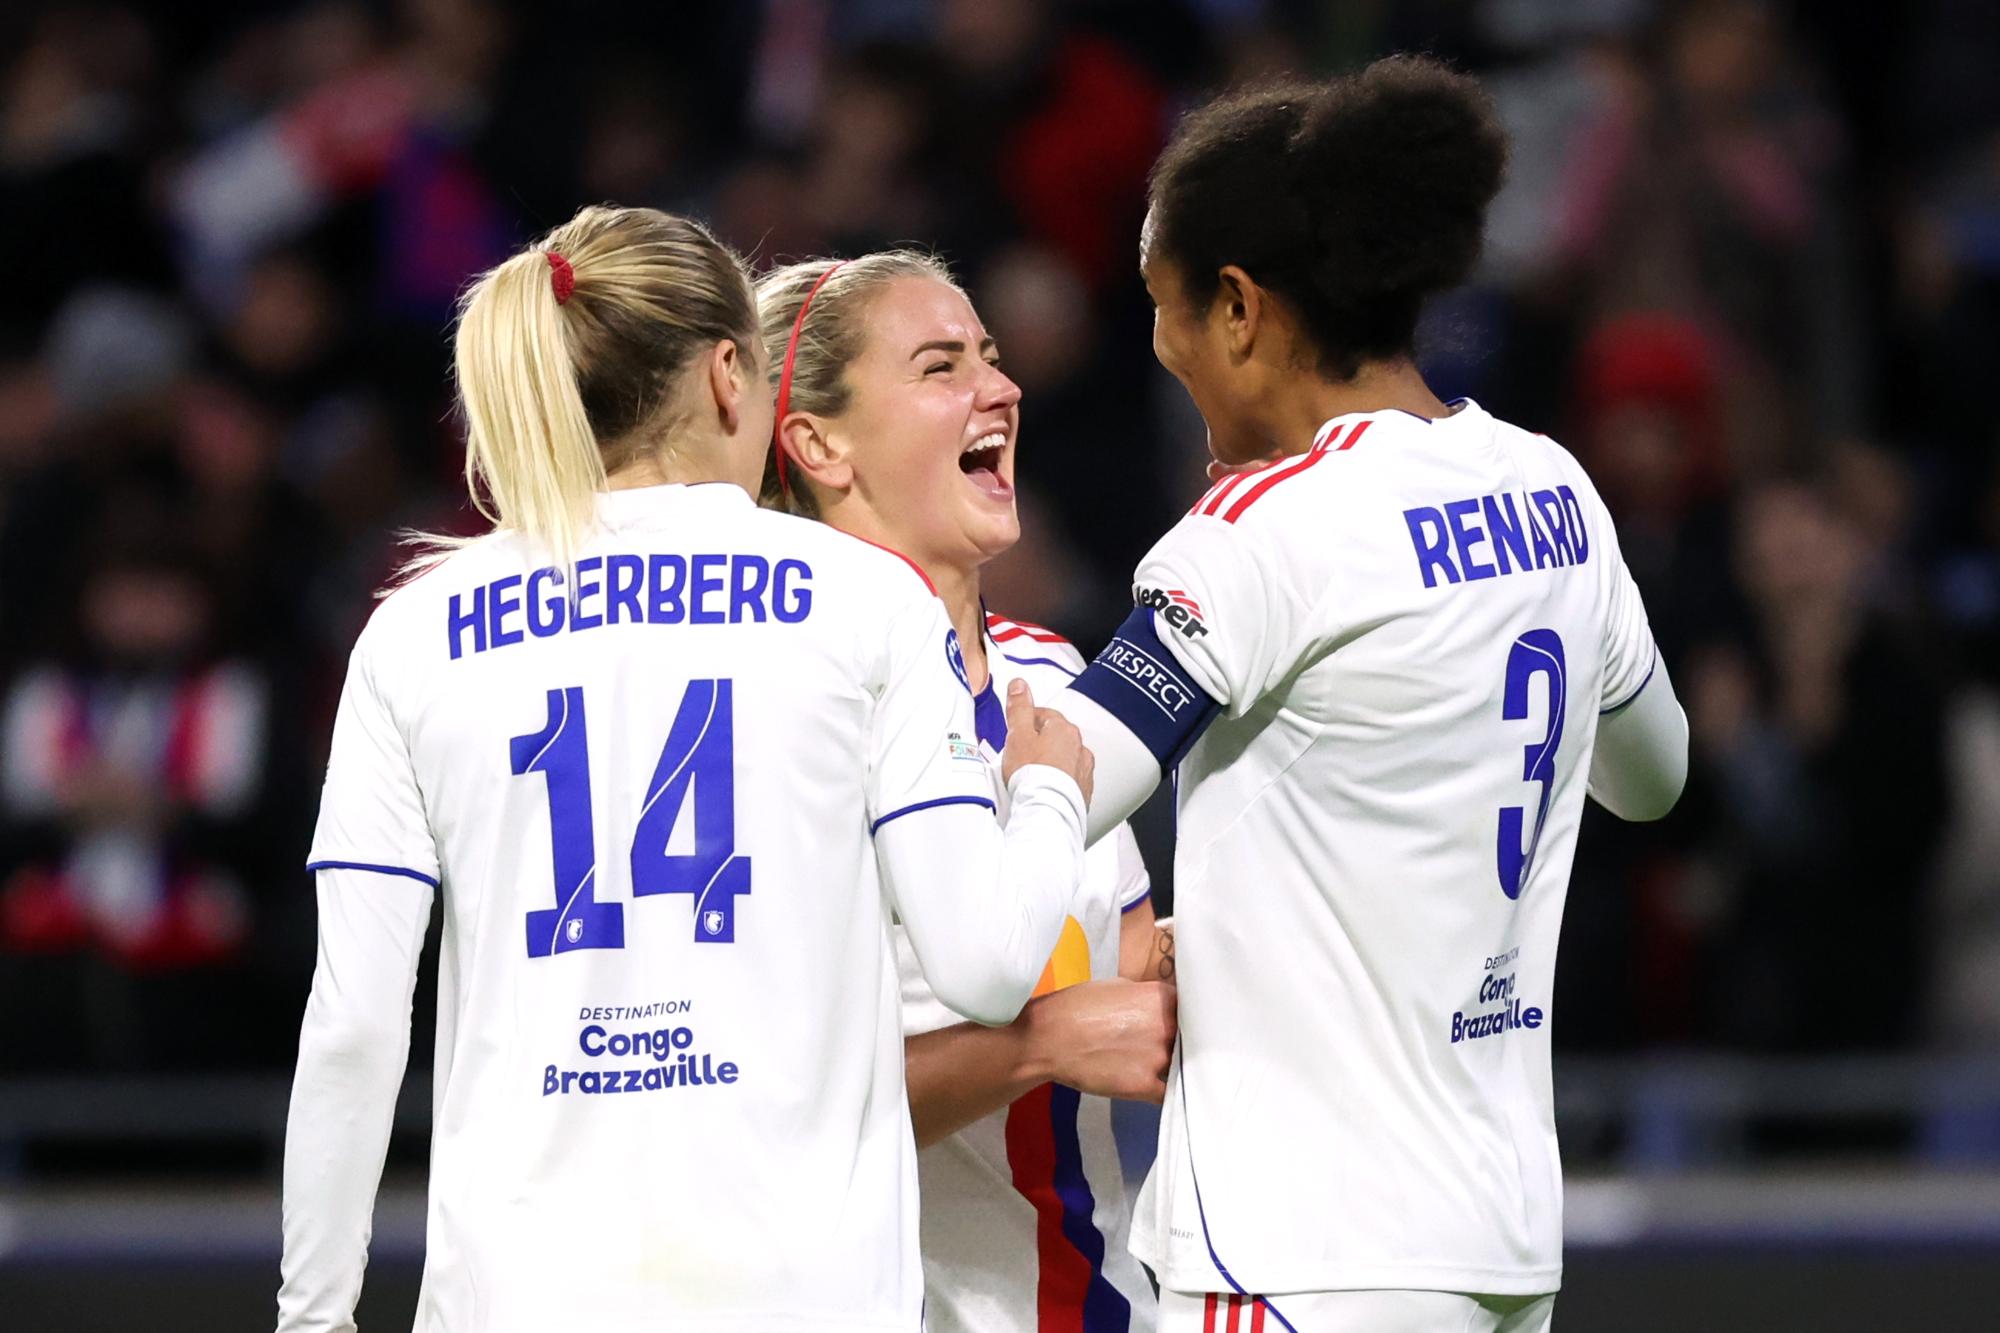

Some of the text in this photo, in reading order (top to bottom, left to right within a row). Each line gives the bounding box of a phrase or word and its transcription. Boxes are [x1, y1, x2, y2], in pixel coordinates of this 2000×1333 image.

[1403, 485, 1589, 588] RENARD
[449, 554, 813, 660] HEGERBERG
[1136, 586, 1208, 638] eber
[1107, 646, 1190, 712] RESPECT
[1497, 628, 1566, 900] 3
[509, 678, 751, 958] 14
[579, 1000, 692, 1020] DESTINATION
[1480, 972, 1515, 1007] Cono
[579, 1024, 693, 1061] Congo
[1451, 998, 1543, 1043] Brazzaille
[543, 1053, 739, 1096] Brazzaville
